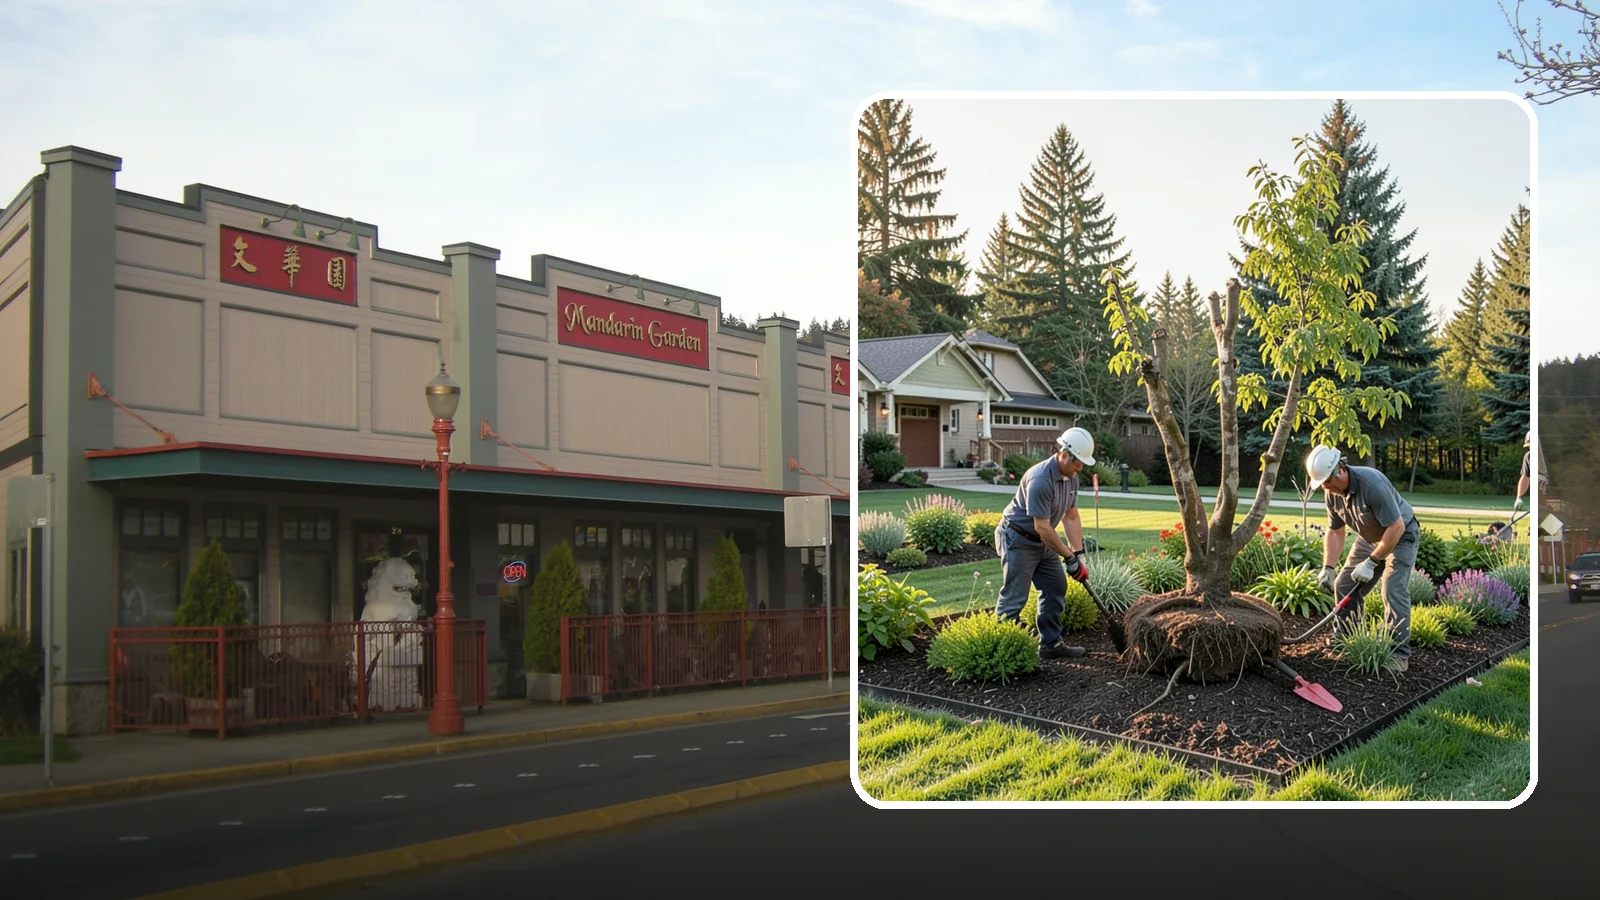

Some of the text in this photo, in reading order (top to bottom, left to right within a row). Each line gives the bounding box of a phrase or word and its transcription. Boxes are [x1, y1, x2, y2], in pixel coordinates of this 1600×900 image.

[231, 235, 346, 291] 文華園
[564, 302, 701, 352] Mandarin Garden
[503, 565, 527, 578] OPEN
